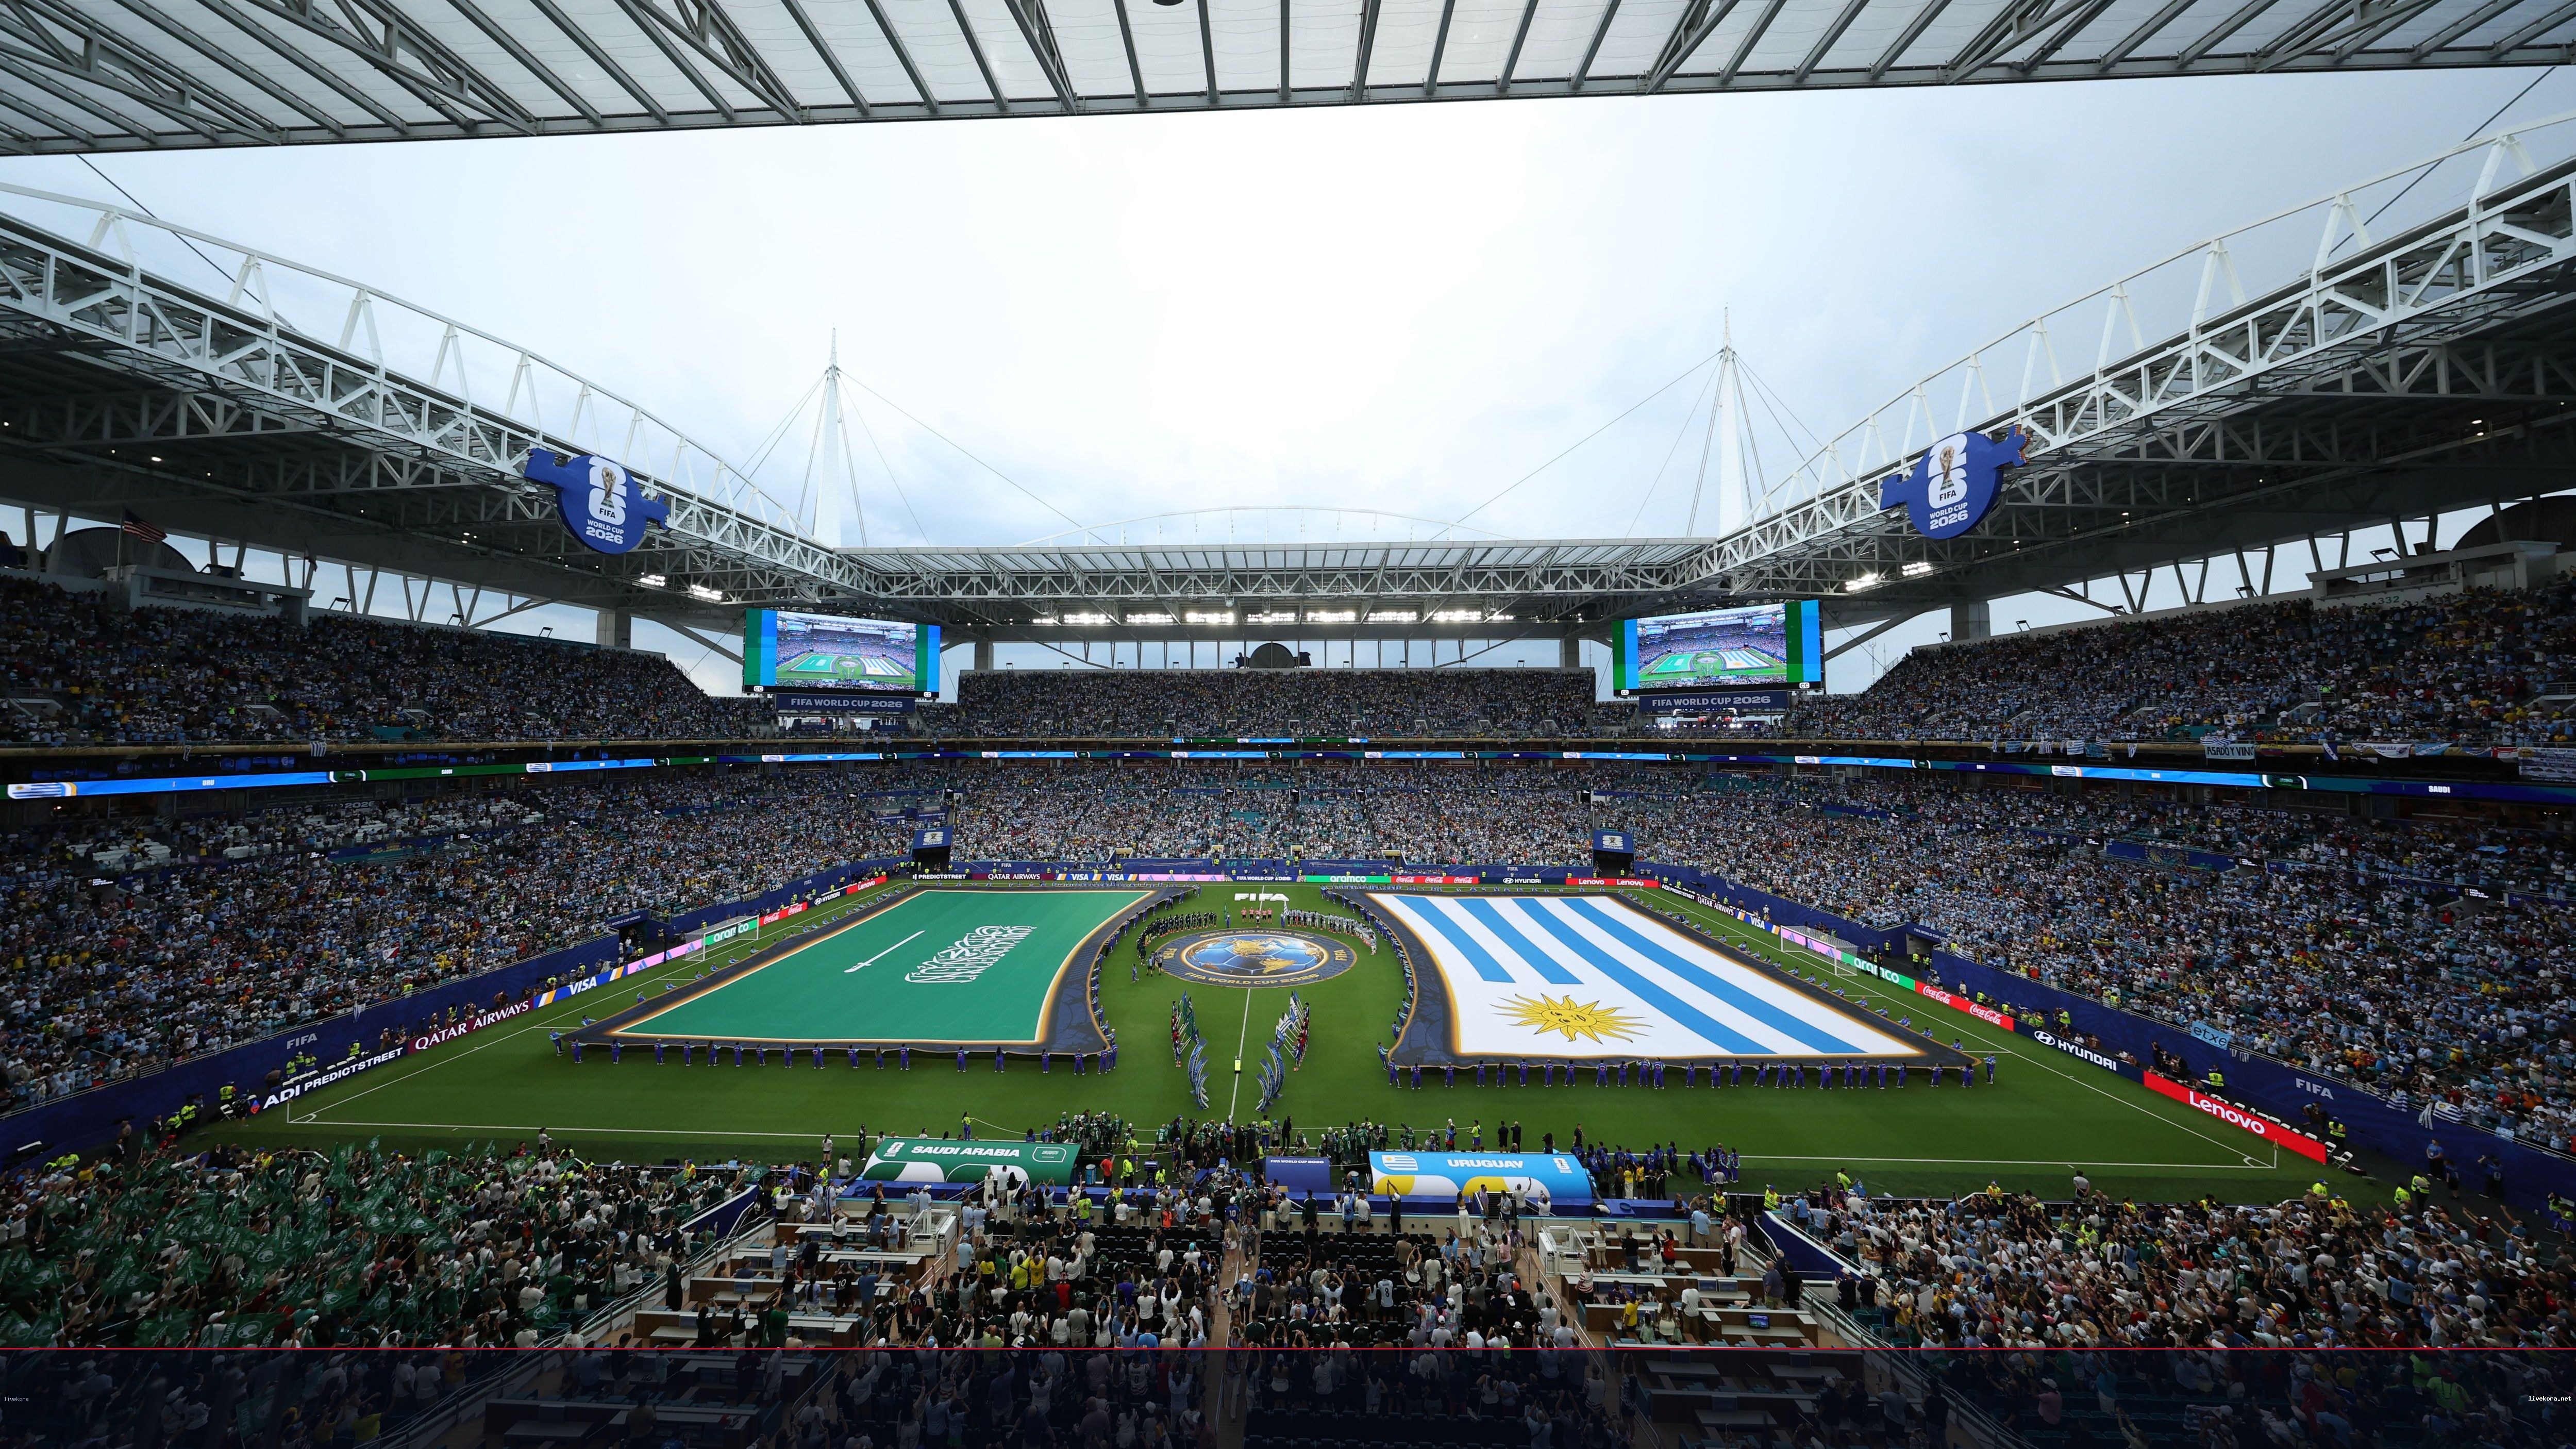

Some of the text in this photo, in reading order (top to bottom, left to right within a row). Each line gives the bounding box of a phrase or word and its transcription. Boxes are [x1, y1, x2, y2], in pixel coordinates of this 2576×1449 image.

[1939, 490, 1957, 502] FIFA
[599, 508, 616, 519] FIFA
[1929, 502, 1968, 519] WORLD CUP
[1930, 509, 1968, 530] 2026
[587, 519, 625, 535] WORLD CUP
[586, 526, 624, 545] 2026
[791, 698, 813, 706] FIFA
[813, 698, 849, 707] WORLD
[871, 700, 903, 708] 2026
[1652, 696, 1771, 707] FIFA WORLD CUP 2026
[2207, 746, 2229, 756] ASADO
[2229, 747, 2235, 756] Y
[858, 880, 875, 891] Lenovo
[822, 891, 840, 902] HYUNDAI
[1234, 893, 1290, 901] FIFA
[1670, 887, 1695, 900] PREDICTSTREET
[788, 904, 803, 915] Coca-Cola
[1697, 895, 1734, 915] QATAR AIRWAYS
[612, 918, 624, 926] WORLD
[763, 912, 780, 924] Coca-Cola
[1750, 915, 1765, 929] VISA
[1163, 948, 1178, 959] FIFA
[1333, 949, 1347, 961] FIFA
[1280, 973, 1319, 984] 2026
[568, 976, 597, 995] VISA
[1922, 985, 1951, 1005] Coca-Cola
[1969, 1004, 2002, 1026] Coca-Cola
[415, 1000, 529, 1051] QATAR AIRWAYS
[286, 1033, 317, 1050] FIFA
[2193, 1025, 2228, 1047] etxe
[2058, 1039, 2117, 1071] HYUNDAI
[263, 1047, 403, 1109] ADI PREDICTSTREET
[2295, 1077, 2334, 1101] FIFA
[2189, 1090, 2266, 1135] Lenovo
[911, 1146, 1020, 1157] SAUDI ARABIA
[1447, 1159, 1524, 1169] URUGUAY
[838, 1279, 846, 1288] 10
[1385, 1288, 1390, 1297] 8
[222, 1323, 237, 1343] SAUDI
